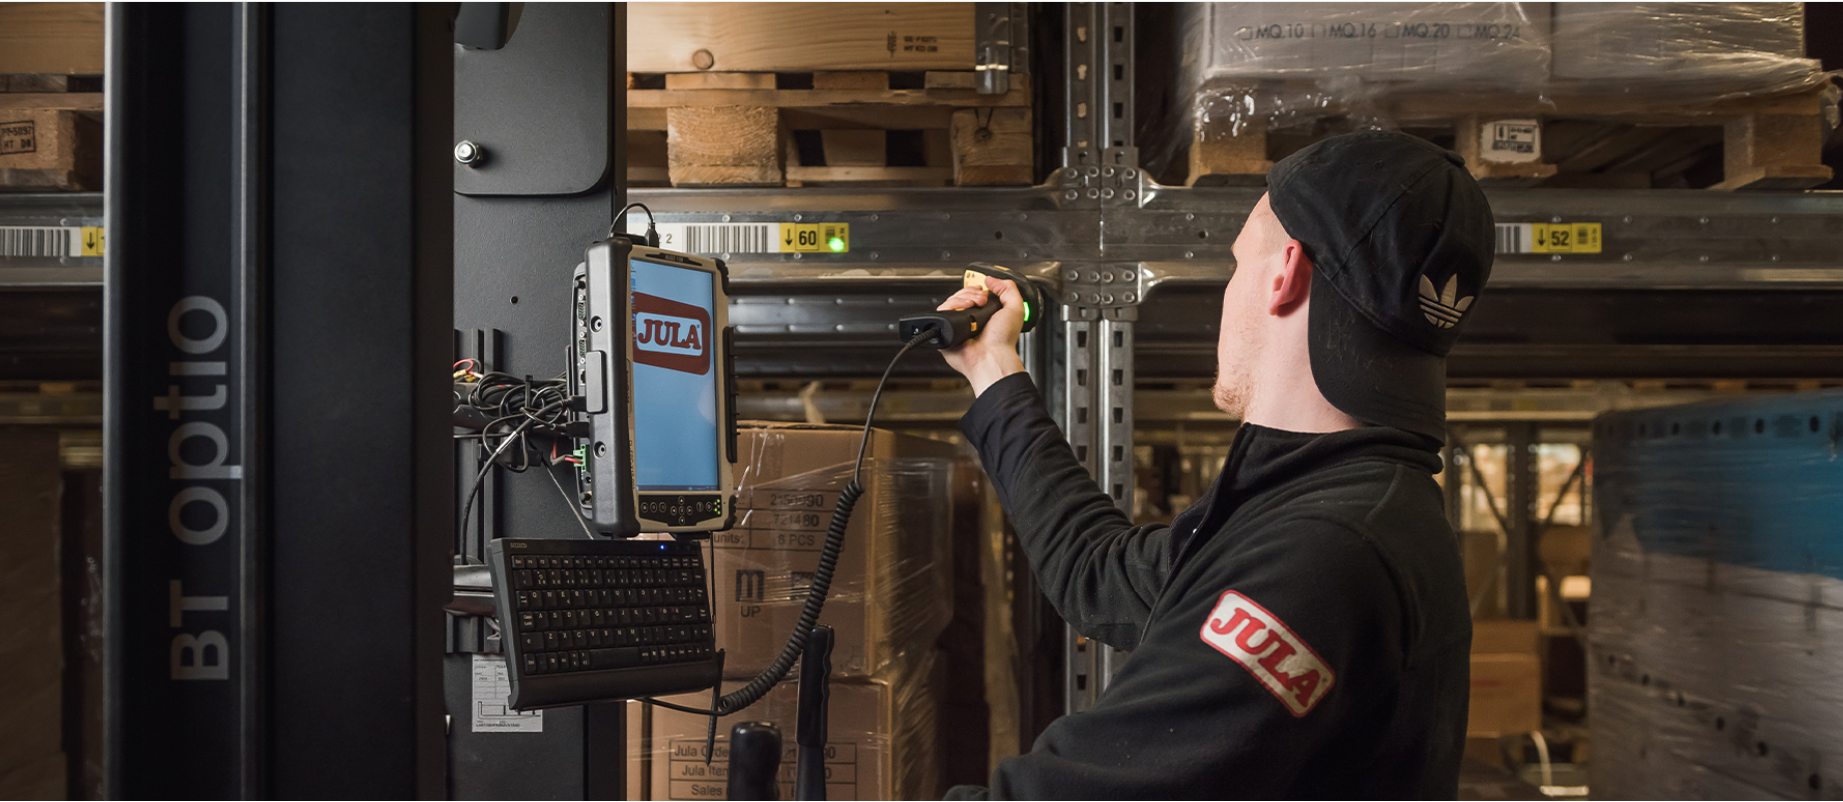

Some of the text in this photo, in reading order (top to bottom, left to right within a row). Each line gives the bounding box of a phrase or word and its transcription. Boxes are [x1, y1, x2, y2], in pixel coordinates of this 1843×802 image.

[1402, 22, 1449, 38] MQ.20
[799, 230, 817, 246] 60
[1551, 230, 1570, 246] 52
[638, 319, 702, 350] JULA
[153, 295, 244, 680] BT optio
[789, 534, 815, 546] PCS
[740, 606, 761, 618] UP
[1210, 607, 1321, 708] JULA
[674, 745, 697, 757] Jula
[682, 765, 705, 776] Jula
[691, 784, 723, 796] Sales
